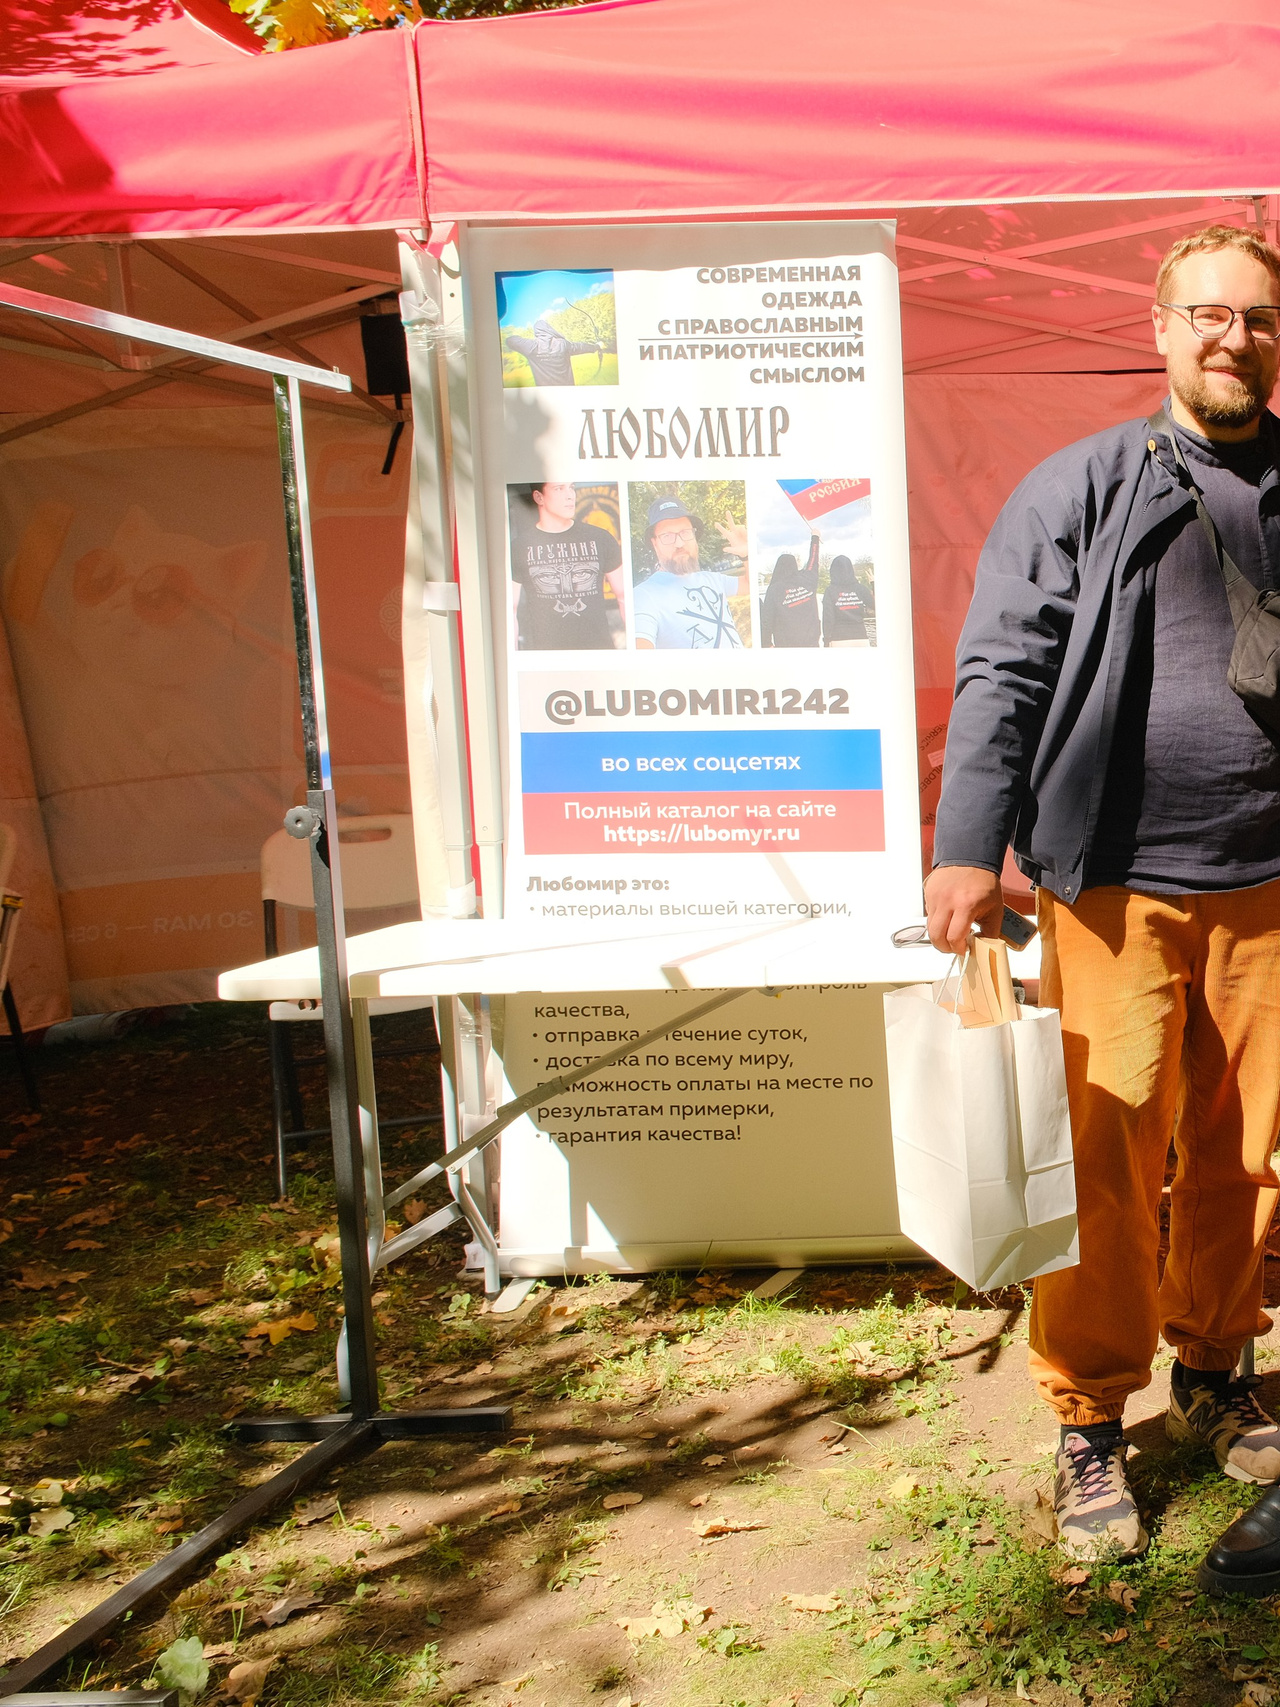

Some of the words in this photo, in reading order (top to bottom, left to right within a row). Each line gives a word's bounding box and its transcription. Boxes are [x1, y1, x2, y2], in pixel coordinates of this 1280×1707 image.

[696, 265, 862, 284] СОВРЕМЕННАЯ
[761, 290, 863, 310] ОДЕЖДА
[657, 319, 671, 336] С
[674, 316, 864, 335] ПРАВОСЛАВНЫМ
[639, 345, 655, 361] И
[657, 342, 865, 360] ПАТРИОТИЧЕСКИМ
[749, 366, 866, 384] СМЫСЛОМ
[577, 405, 790, 461] ЛЮБОМИР
[544, 687, 850, 725] @LUBOMIR1242
[601, 756, 630, 772] во
[636, 755, 688, 772] всех
[693, 754, 802, 774] соцсетях
[564, 800, 651, 820] Полный
[656, 805, 739, 819] каталог
[745, 804, 772, 818] на
[776, 801, 837, 818] сайте
[603, 823, 801, 847] https://lubomyr.ru
[526, 876, 627, 894] Любомир
[631, 878, 671, 892] это:
[542, 903, 653, 918] материалы
[659, 901, 738, 916] высшей
[744, 901, 852, 918] категории,
[534, 1005, 630, 1019] качества,
[545, 1029, 640, 1046] отправка
[747, 1028, 808, 1044] суток,
[546, 1054, 640, 1070] достка
[646, 1054, 669, 1067] по
[674, 1053, 734, 1069] всему
[739, 1053, 794, 1069] миру,
[537, 1079, 671, 1093] можность
[677, 1077, 751, 1092] оплаты
[756, 1077, 781, 1090] на
[786, 1076, 844, 1089] месте
[848, 1075, 874, 1088] по
[537, 1104, 664, 1123] результатам
[669, 1102, 775, 1120] примерки,
[548, 1127, 642, 1147] гарантия
[647, 1124, 742, 1142] качества!
